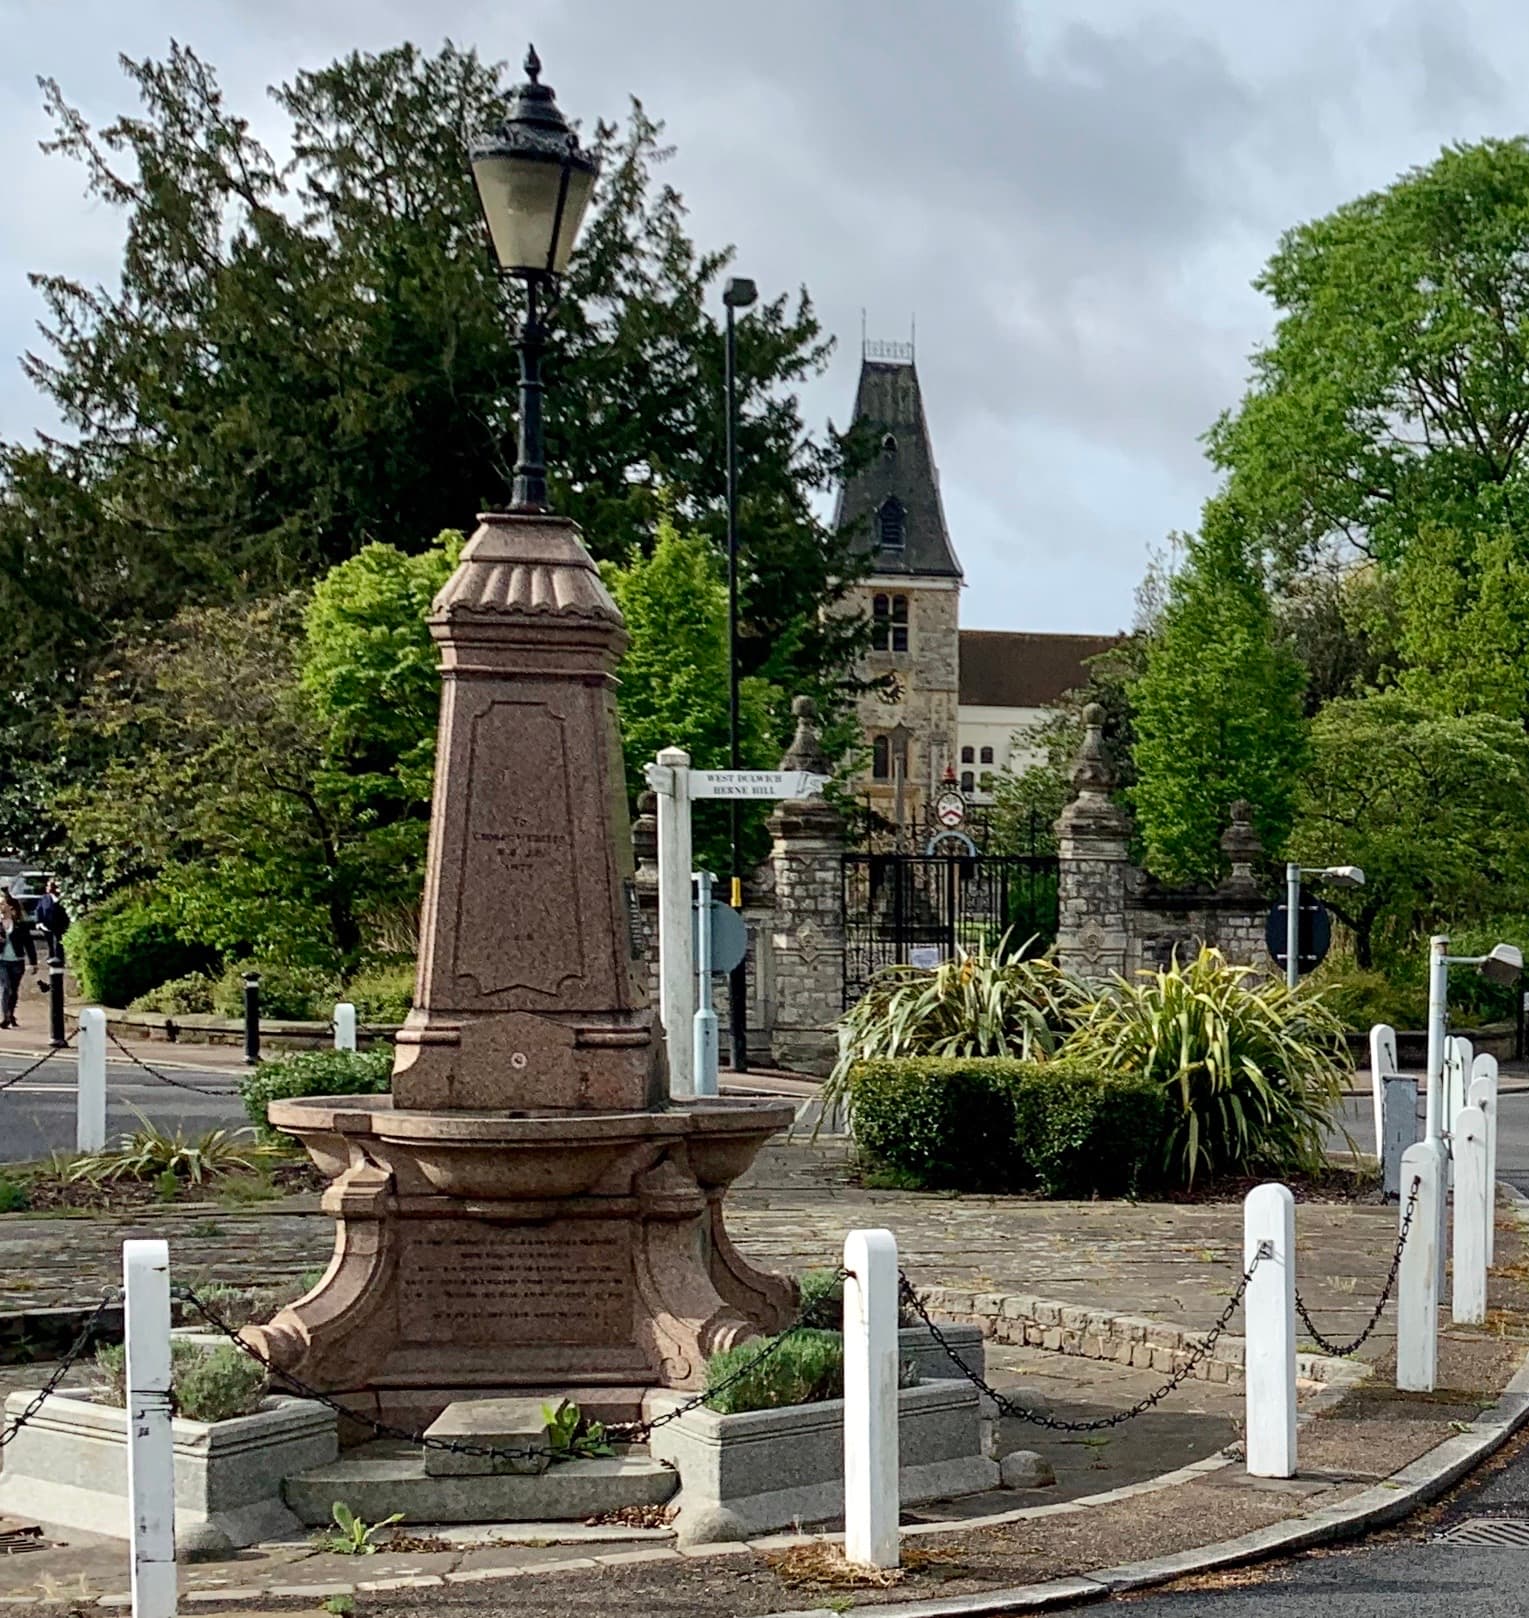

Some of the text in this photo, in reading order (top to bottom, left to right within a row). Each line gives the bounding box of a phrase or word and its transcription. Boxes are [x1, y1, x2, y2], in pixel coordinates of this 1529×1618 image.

[706, 774, 783, 783] WEST DULWICH
[713, 786, 776, 795] HERNE HILL
